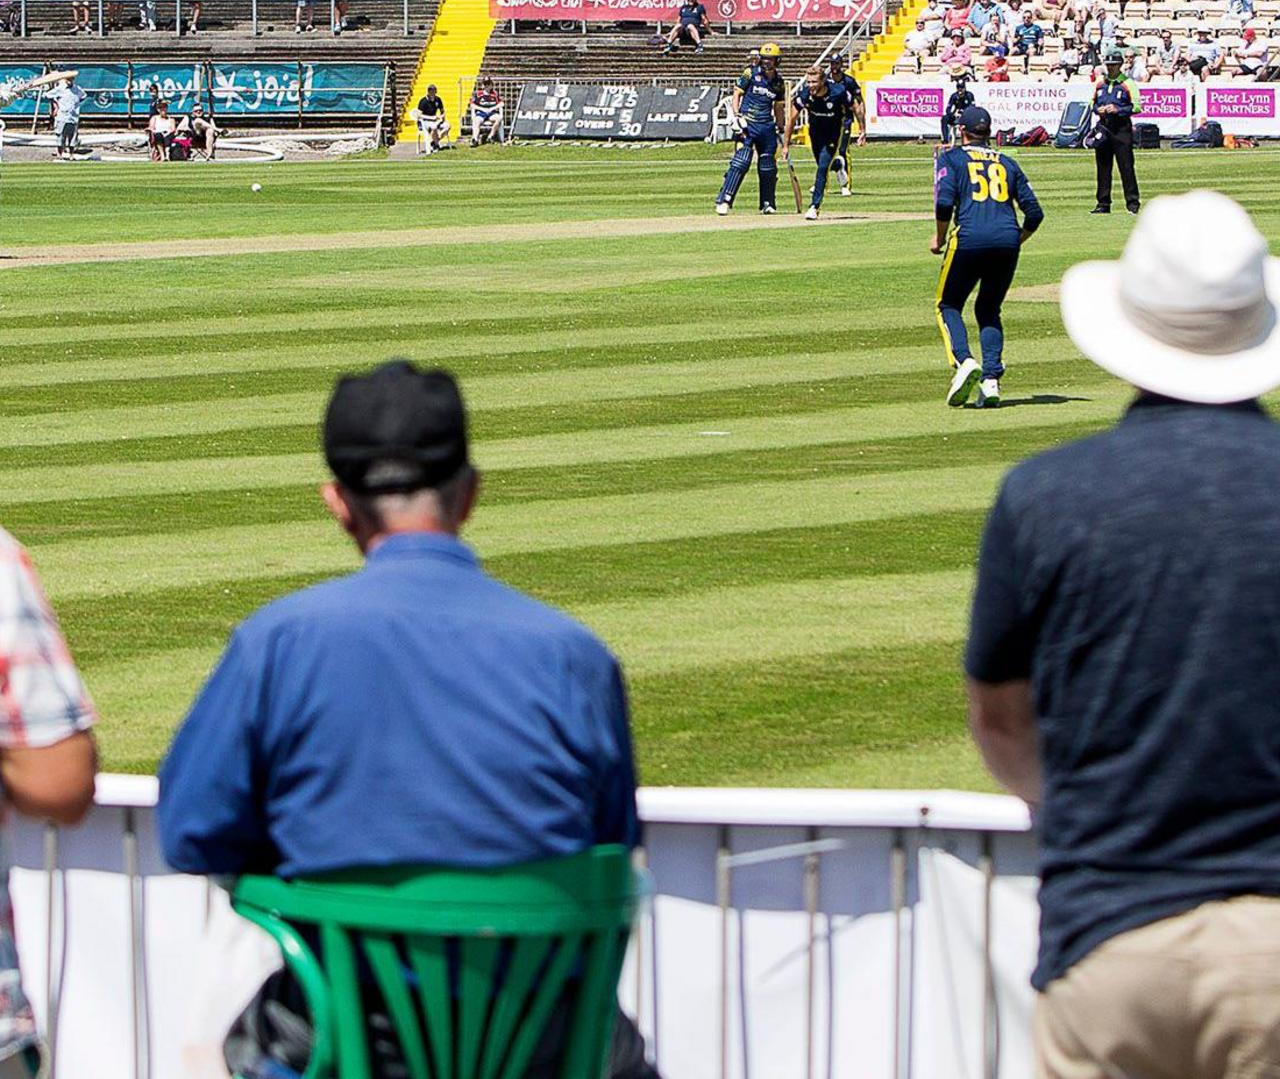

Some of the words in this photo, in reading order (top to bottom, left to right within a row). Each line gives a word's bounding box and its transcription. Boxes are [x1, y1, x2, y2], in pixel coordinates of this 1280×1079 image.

[602, 85, 639, 94] TOTAL
[699, 85, 712, 100] 7
[989, 88, 1067, 98] PREVENTING
[598, 91, 638, 107] 125
[880, 91, 909, 103] Peter
[912, 91, 939, 104] Lynn
[1153, 92, 1181, 105] Lynn
[1210, 92, 1238, 103] Peter
[1241, 92, 1270, 105] Lynn
[687, 98, 701, 112] 5
[890, 104, 939, 113] PARTNERS
[1140, 105, 1182, 114] ARTNERS
[1220, 104, 1270, 114] PARTNERS
[518, 110, 547, 120] LAST
[547, 110, 574, 120] MAN
[582, 106, 616, 116] WKTS
[619, 108, 634, 122] 5
[647, 113, 677, 122] LAST
[544, 121, 569, 135] 12
[575, 120, 614, 129] OVERS
[618, 123, 642, 136] 30
[967, 161, 1009, 203] 58
